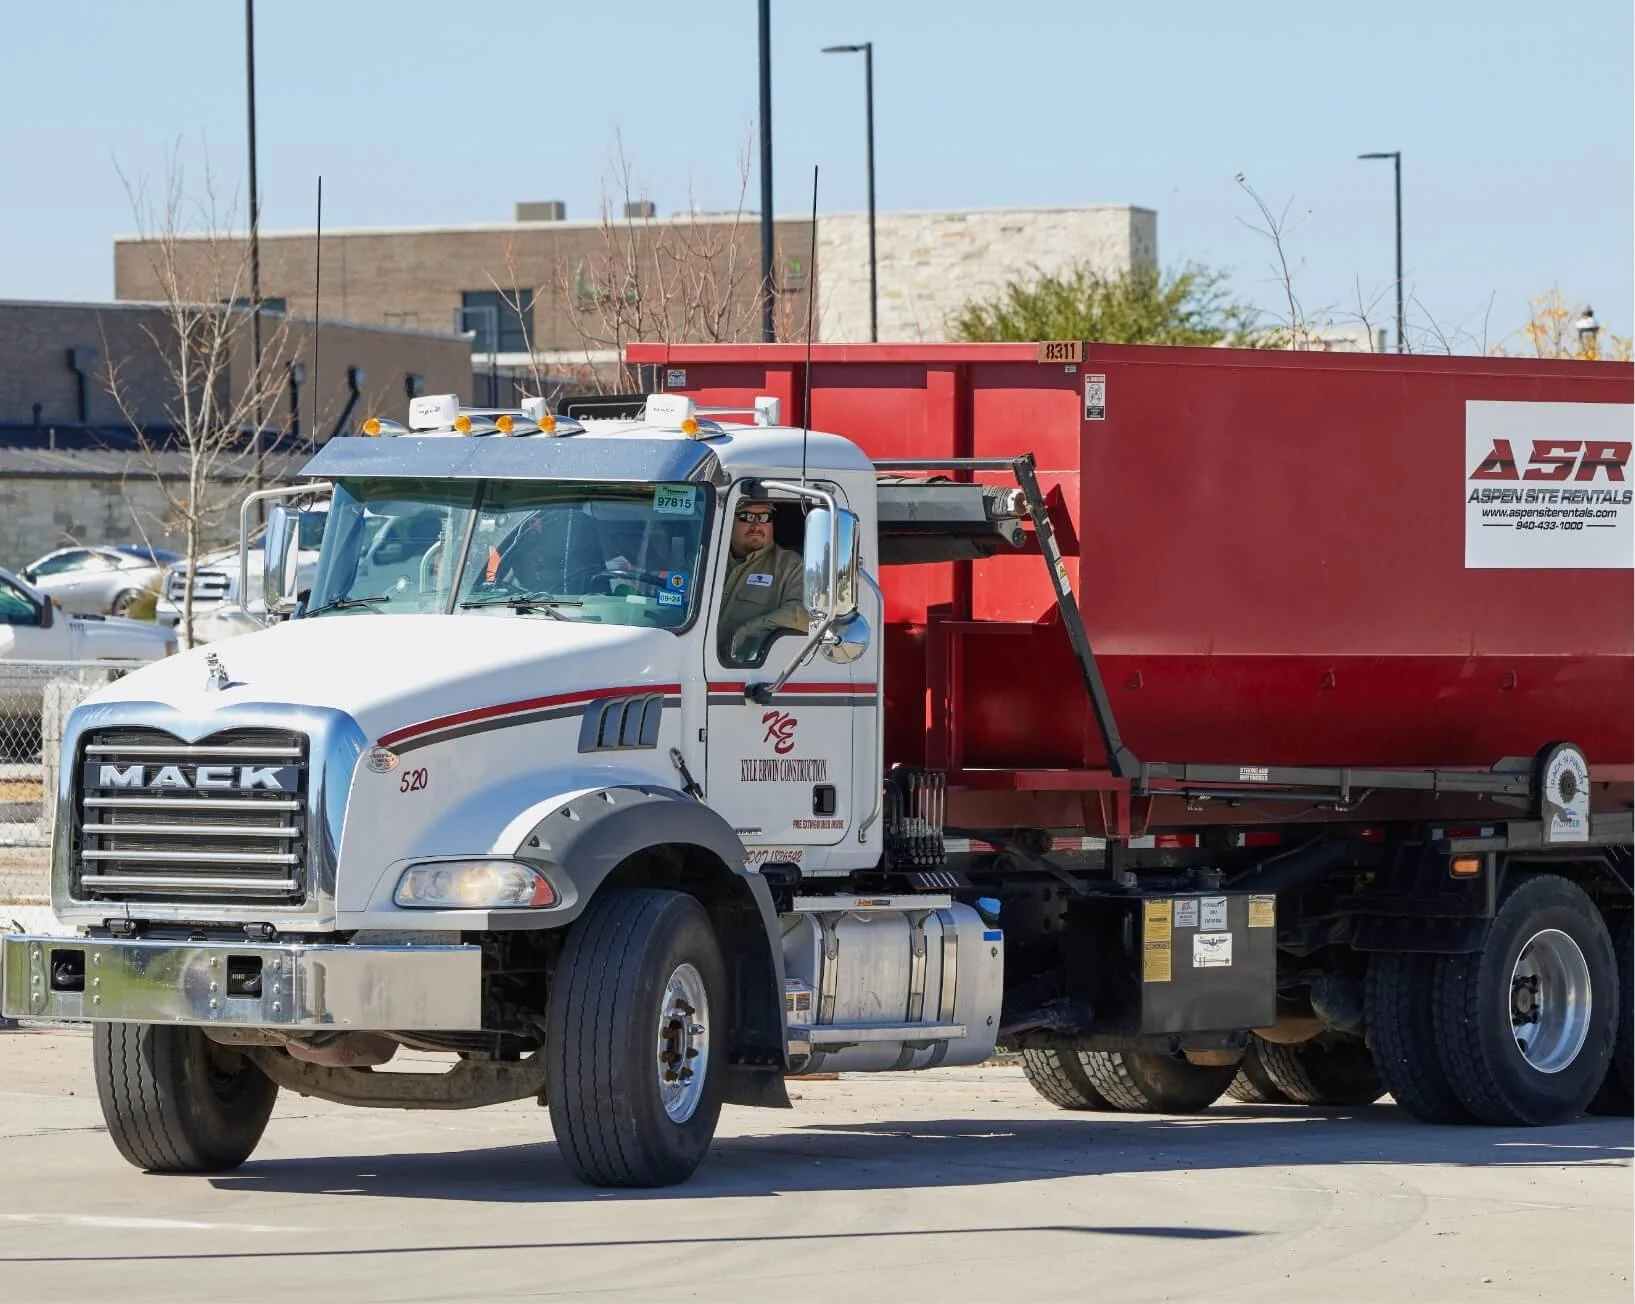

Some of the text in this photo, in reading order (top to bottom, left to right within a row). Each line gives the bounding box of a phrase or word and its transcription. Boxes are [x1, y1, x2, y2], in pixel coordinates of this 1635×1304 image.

[1046, 343, 1075, 360] 8311
[1468, 439, 1633, 481] ASR
[657, 496, 692, 509] 97815
[1468, 488, 1633, 505] ASPEN SITE RENTALS
[1482, 507, 1617, 520] www.aspensiterentals.com
[1515, 521, 1584, 531] 940-433-1000
[762, 710, 798, 754] KE
[99, 765, 284, 790] MACK
[400, 767, 428, 793] 520
[740, 759, 827, 782] KYLE ERWIN CONSTRUCTION
